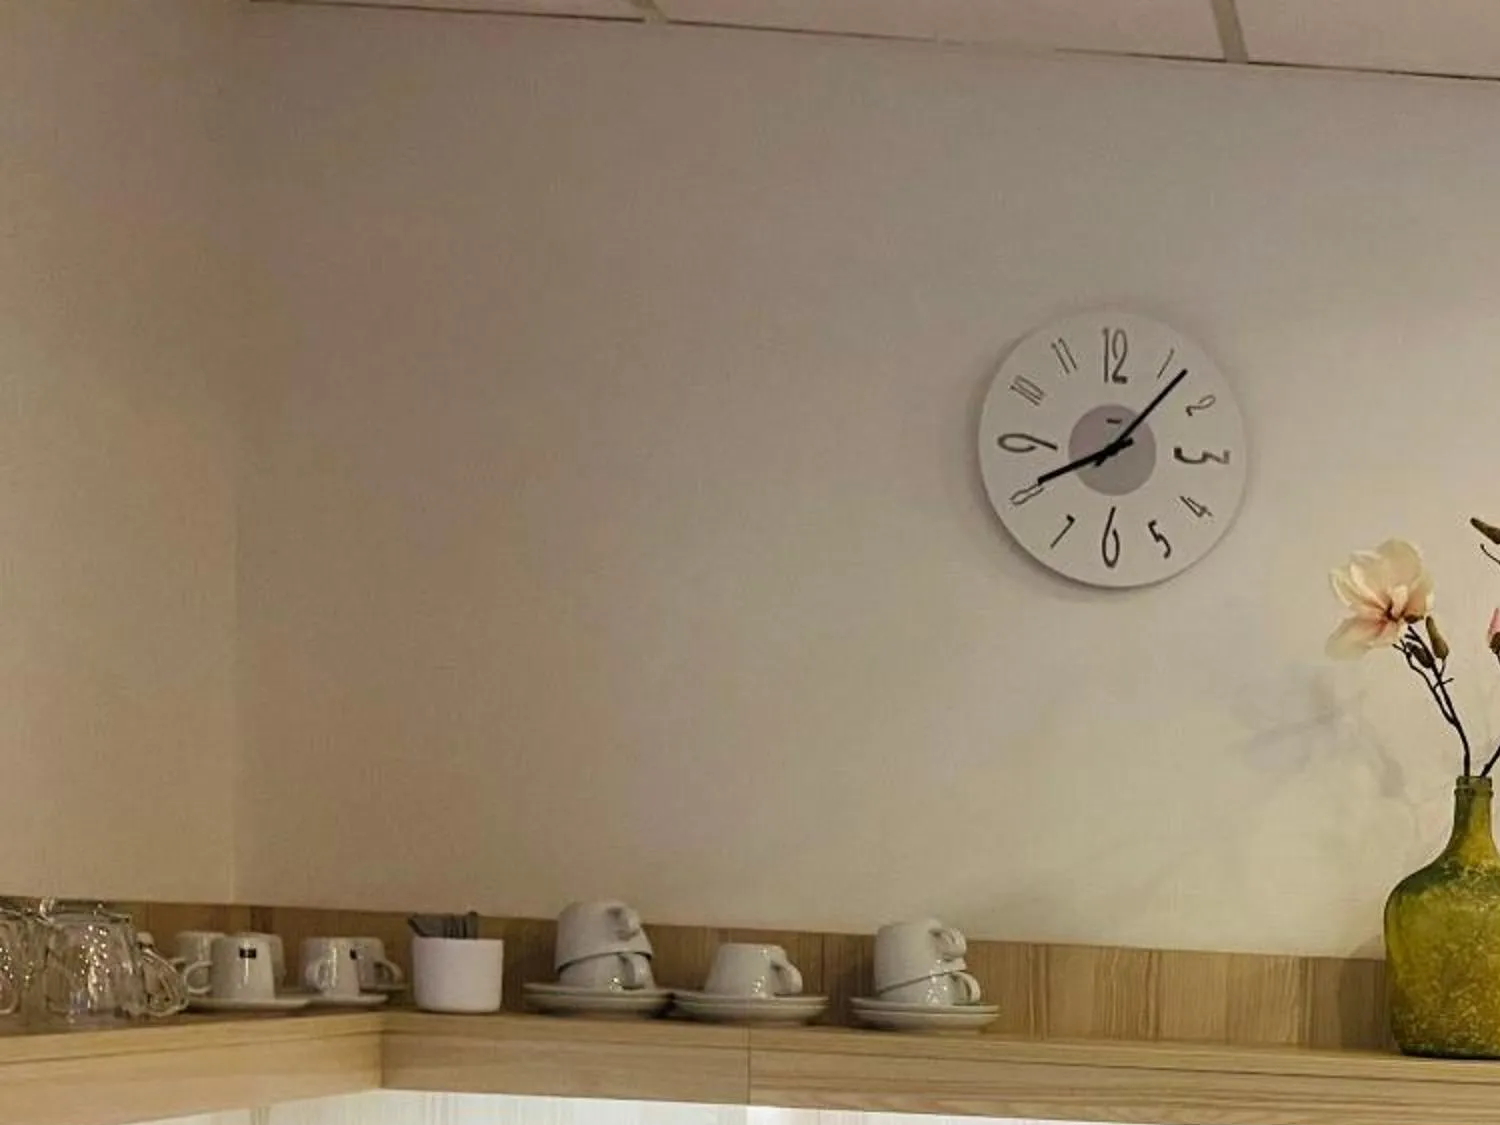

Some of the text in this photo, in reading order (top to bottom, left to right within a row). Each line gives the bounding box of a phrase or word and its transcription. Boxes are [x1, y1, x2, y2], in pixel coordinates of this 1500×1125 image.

[1051, 338, 1077, 374] 11
[1102, 327, 1128, 384] 12
[1157, 348, 1175, 379] 1
[1186, 395, 1216, 416] 2
[998, 433, 1058, 452] 9
[1174, 447, 1230, 464] 3
[1179, 496, 1212, 517] 4
[1050, 514, 1075, 548] 7
[1102, 506, 1120, 567] 6
[1148, 521, 1171, 558] 5
